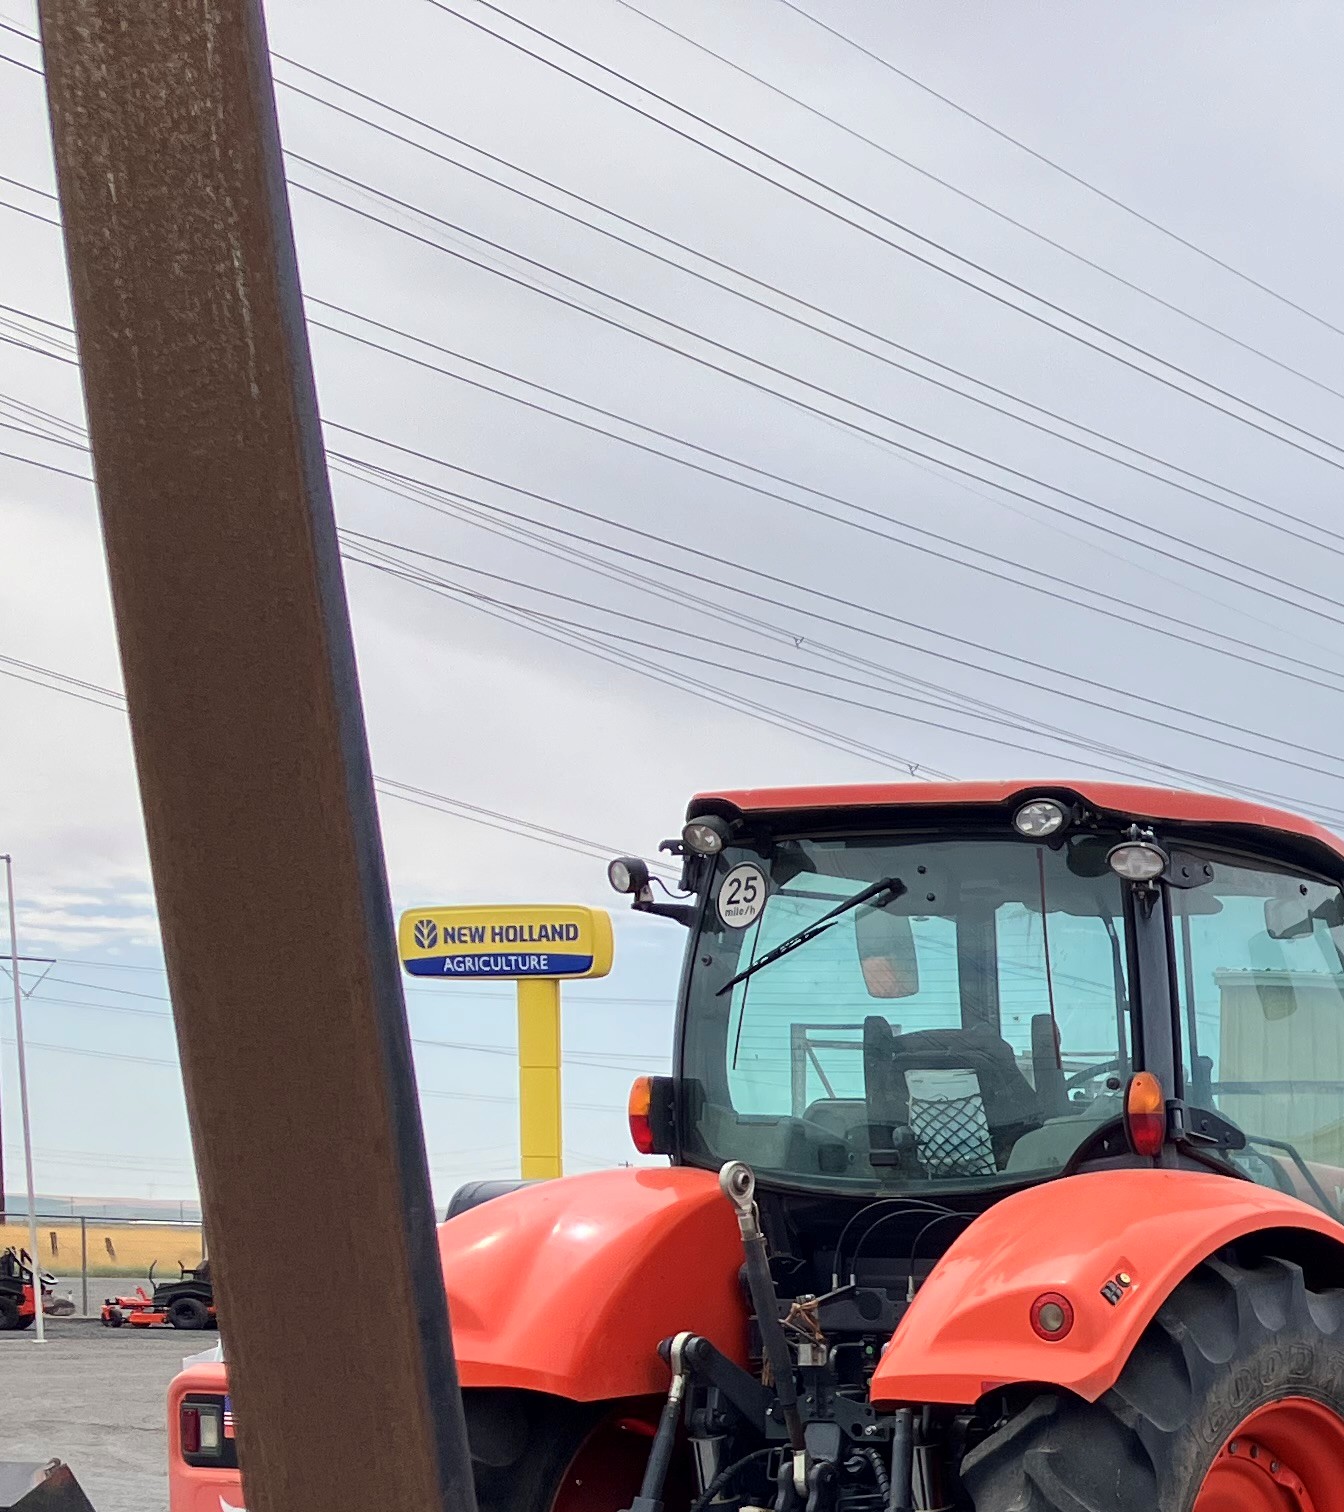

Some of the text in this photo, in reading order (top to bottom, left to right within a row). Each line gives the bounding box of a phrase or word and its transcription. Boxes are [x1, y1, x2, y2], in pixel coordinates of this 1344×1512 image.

[726, 876, 757, 905] 25
[725, 905, 756, 917] mile/h
[443, 924, 579, 944] NEW HOLLAND
[443, 955, 549, 972] AGRICULTURE
